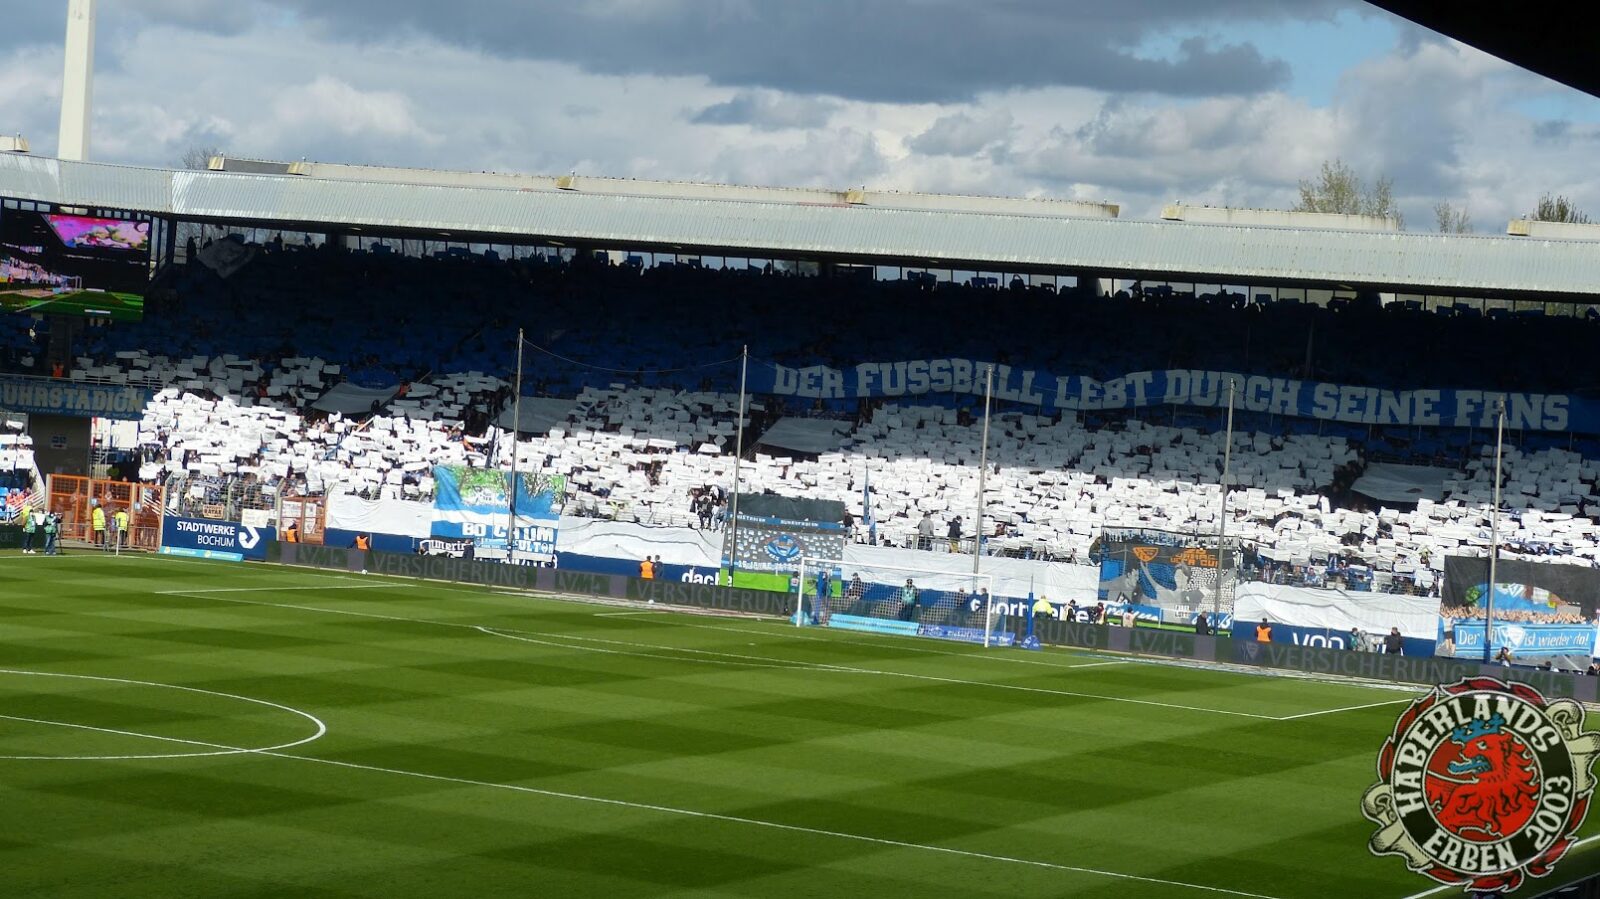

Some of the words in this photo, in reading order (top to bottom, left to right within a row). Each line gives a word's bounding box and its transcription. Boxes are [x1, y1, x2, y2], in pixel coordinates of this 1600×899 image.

[774, 363, 845, 398] DER
[856, 358, 1043, 405] FUSSBALL
[1054, 371, 1153, 410] LEBT
[1164, 369, 1300, 416] DURCH
[1312, 382, 1440, 426] SEINE
[1454, 389, 1570, 431] FANS
[176, 520, 235, 536] STADTWERKE
[197, 534, 235, 548] BOCHUM
[373, 551, 528, 587] VERSICHERUNG
[1460, 629, 1480, 645] Der
[1538, 634, 1572, 646] wieder
